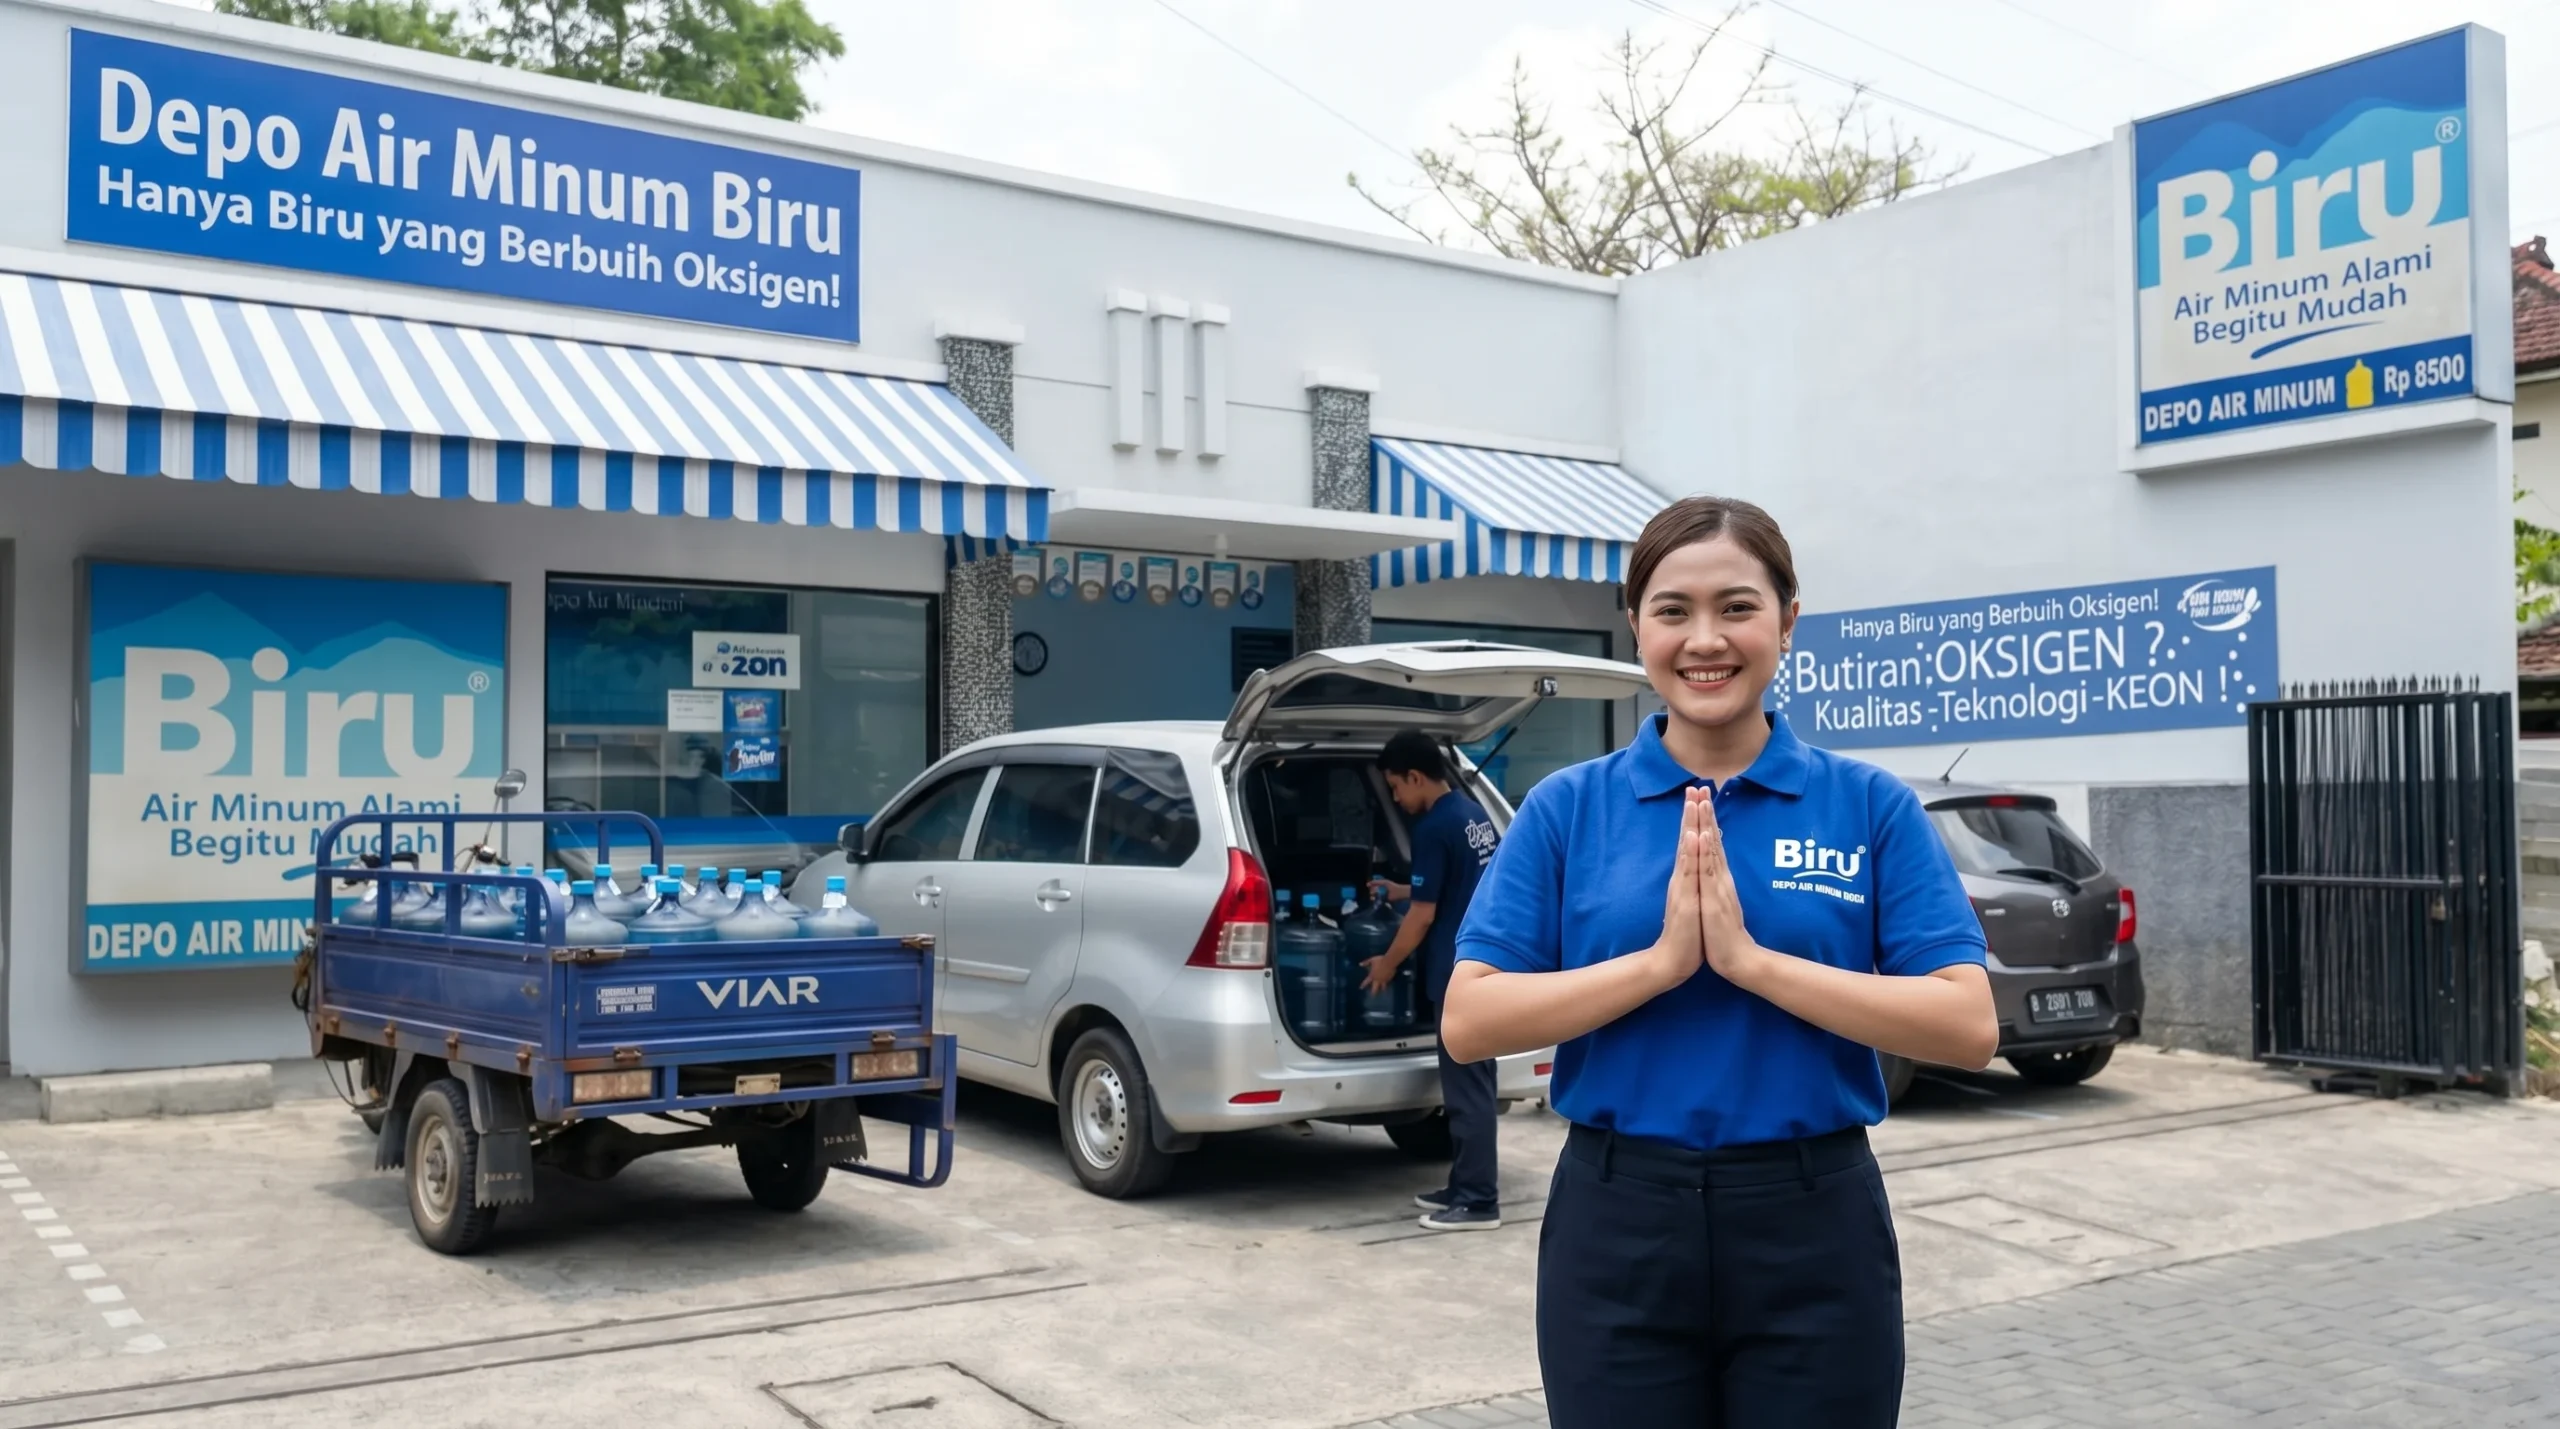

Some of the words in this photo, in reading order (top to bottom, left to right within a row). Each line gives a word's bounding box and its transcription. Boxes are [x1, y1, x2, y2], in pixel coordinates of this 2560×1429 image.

[100, 67, 300, 179] Depo
[322, 107, 431, 190] Air
[452, 128, 689, 232] Minum
[713, 171, 841, 255] Biru
[99, 165, 252, 231] Hanya
[269, 190, 363, 240] Biru
[377, 215, 485, 267] yang
[500, 225, 662, 283] Berbuih
[674, 251, 840, 309] Oksigen!
[2174, 294, 2214, 320] Air
[2225, 273, 2329, 310] Minum
[2341, 244, 2432, 288] Alami
[2193, 310, 2286, 345] Begitu
[2297, 282, 2407, 326] Mudah
[2384, 365, 2411, 398] Rp
[2414, 354, 2465, 387] 8500
[2145, 399, 2202, 432] DEPO
[2208, 392, 2247, 422] AIR
[2254, 376, 2335, 414] MINUM
[1840, 618, 1895, 642] Hanya
[1899, 612, 1934, 634] Biru
[1938, 611, 1984, 636] yang
[1989, 599, 2064, 626] Berbuih
[2069, 588, 2159, 620] Oksigen!
[1935, 626, 2125, 683] OKSIGEN
[1815, 695, 1923, 731] Kualitas
[141, 793, 198, 822] Air
[211, 793, 346, 822] Minum
[361, 793, 461, 814] Alami
[171, 828, 295, 865] Begitu
[1772, 880, 1797, 890] DEPO
[1798, 882, 1814, 892] AIR
[1815, 883, 1842, 899] MINUM
[87, 922, 177, 959] DEPO
[186, 920, 243, 955] AIR
[253, 917, 316, 952] MIN
[696, 976, 820, 1009] VIAR
